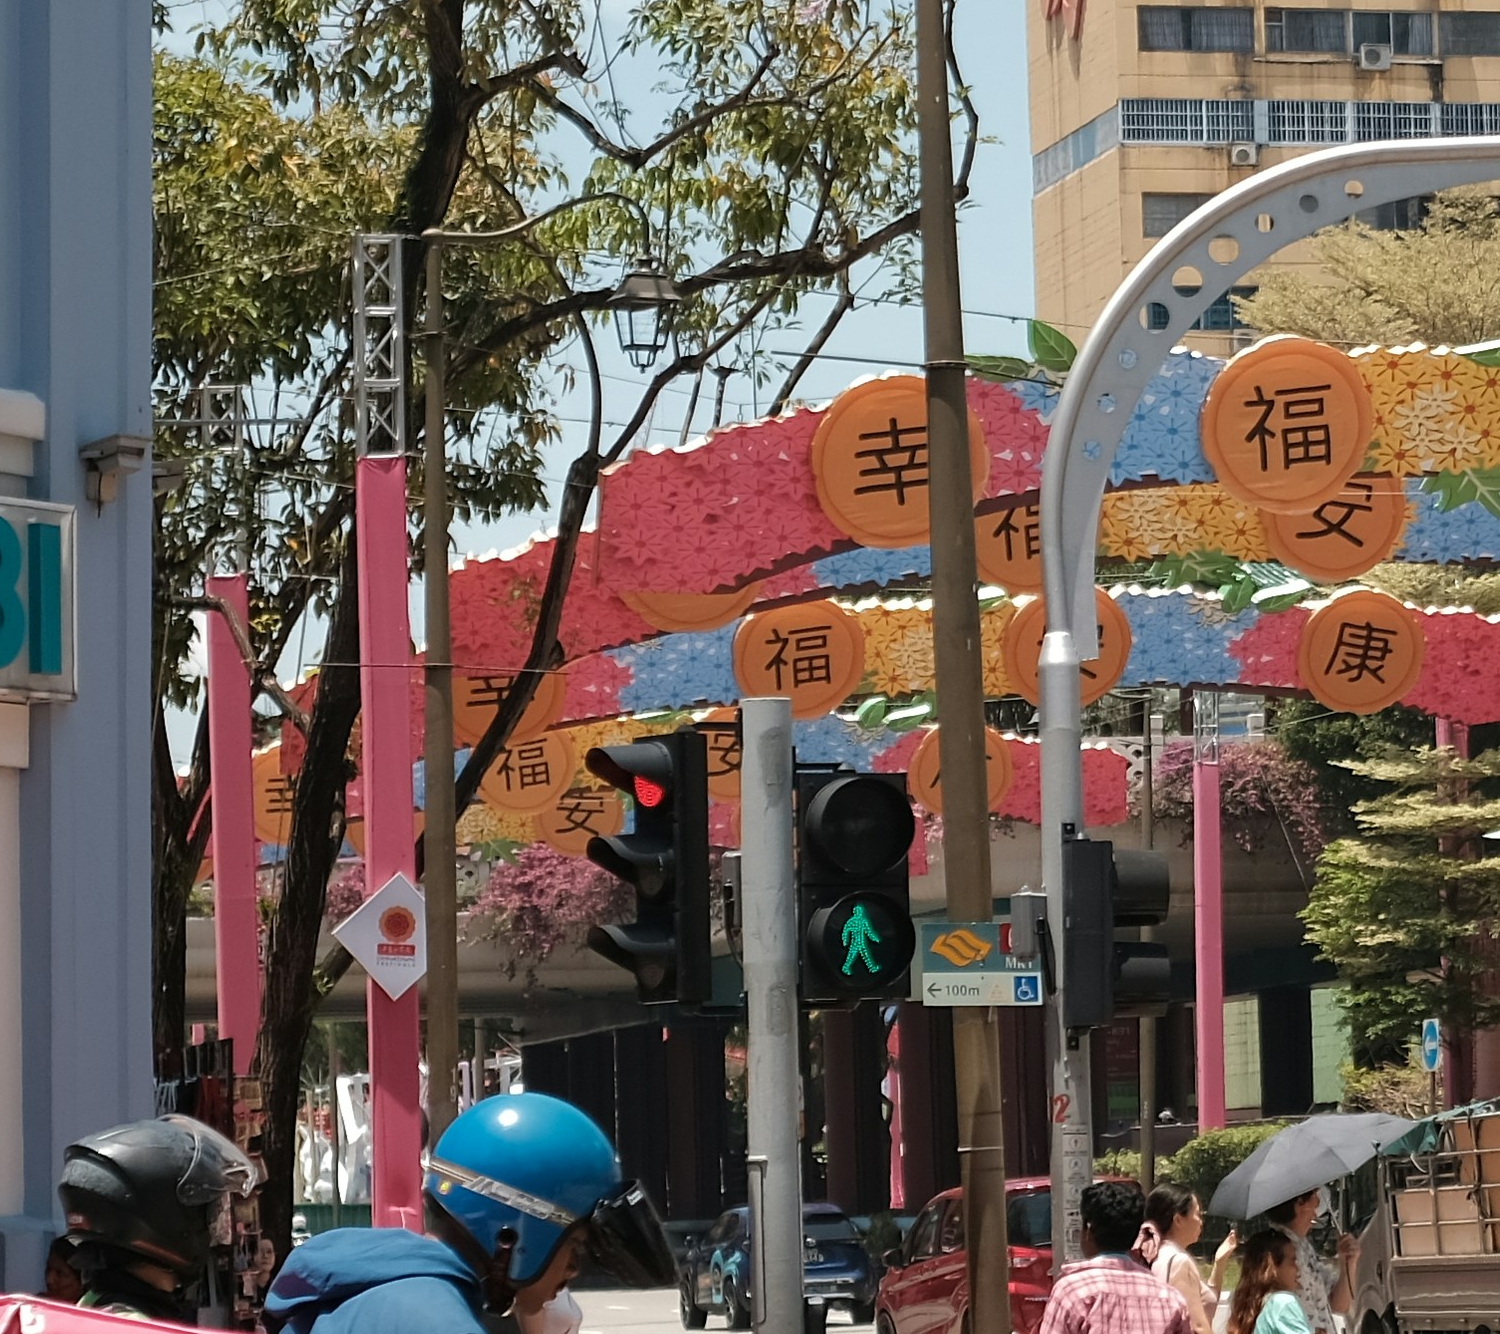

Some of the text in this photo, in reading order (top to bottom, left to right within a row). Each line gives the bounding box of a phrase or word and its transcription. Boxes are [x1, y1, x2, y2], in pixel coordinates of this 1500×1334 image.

[854, 417, 928, 505] 幸
[1243, 384, 1332, 471] 福
[764, 624, 834, 692] 福
[1324, 622, 1398, 684] 康
[497, 738, 551, 792] 福
[945, 984, 980, 997] 100m
